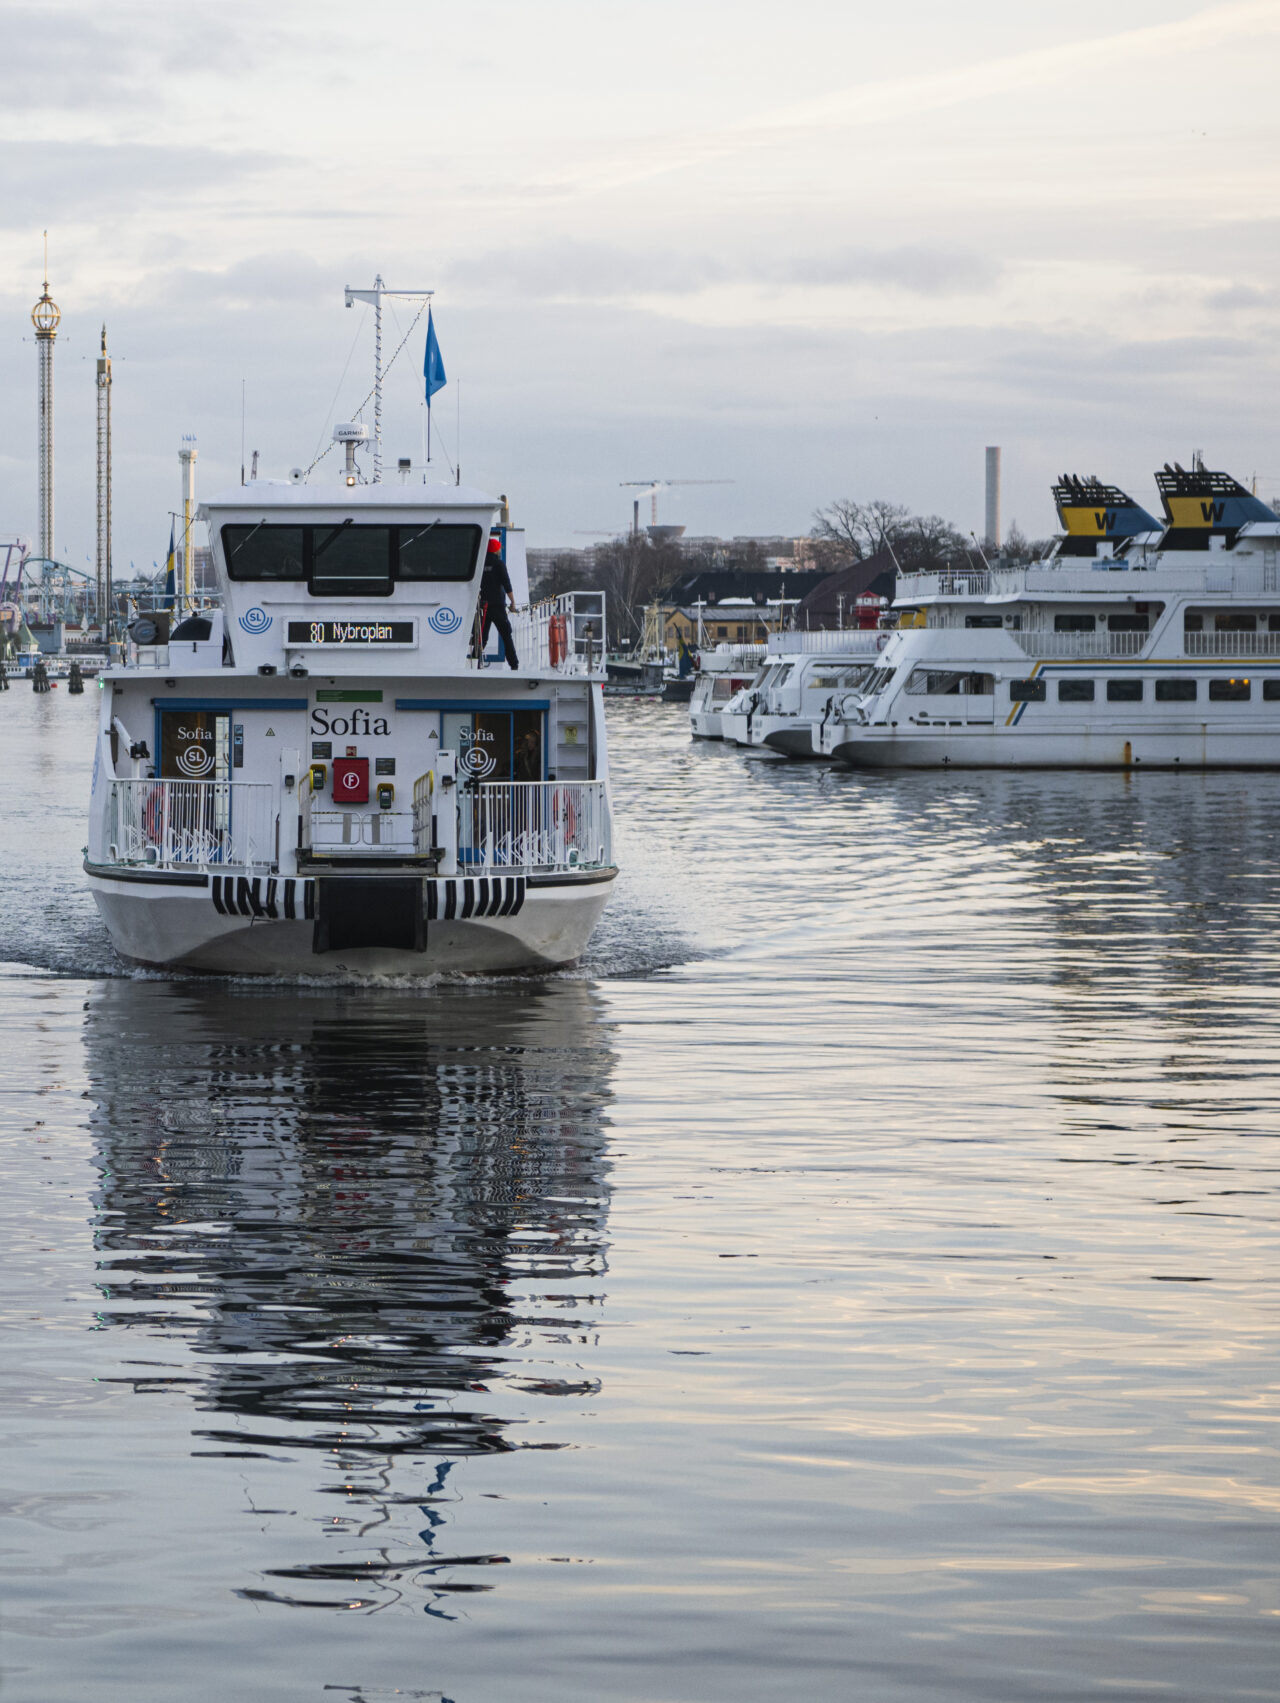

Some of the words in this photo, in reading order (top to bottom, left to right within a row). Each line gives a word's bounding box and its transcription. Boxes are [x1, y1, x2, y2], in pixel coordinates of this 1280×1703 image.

[1094, 512, 1116, 530] W
[1200, 502, 1225, 522] W
[310, 622, 324, 643] 80
[333, 622, 393, 643] Nybroplan
[310, 708, 391, 735] Sofia
[177, 727, 213, 740] Sofia
[459, 728, 495, 741] Sofia
